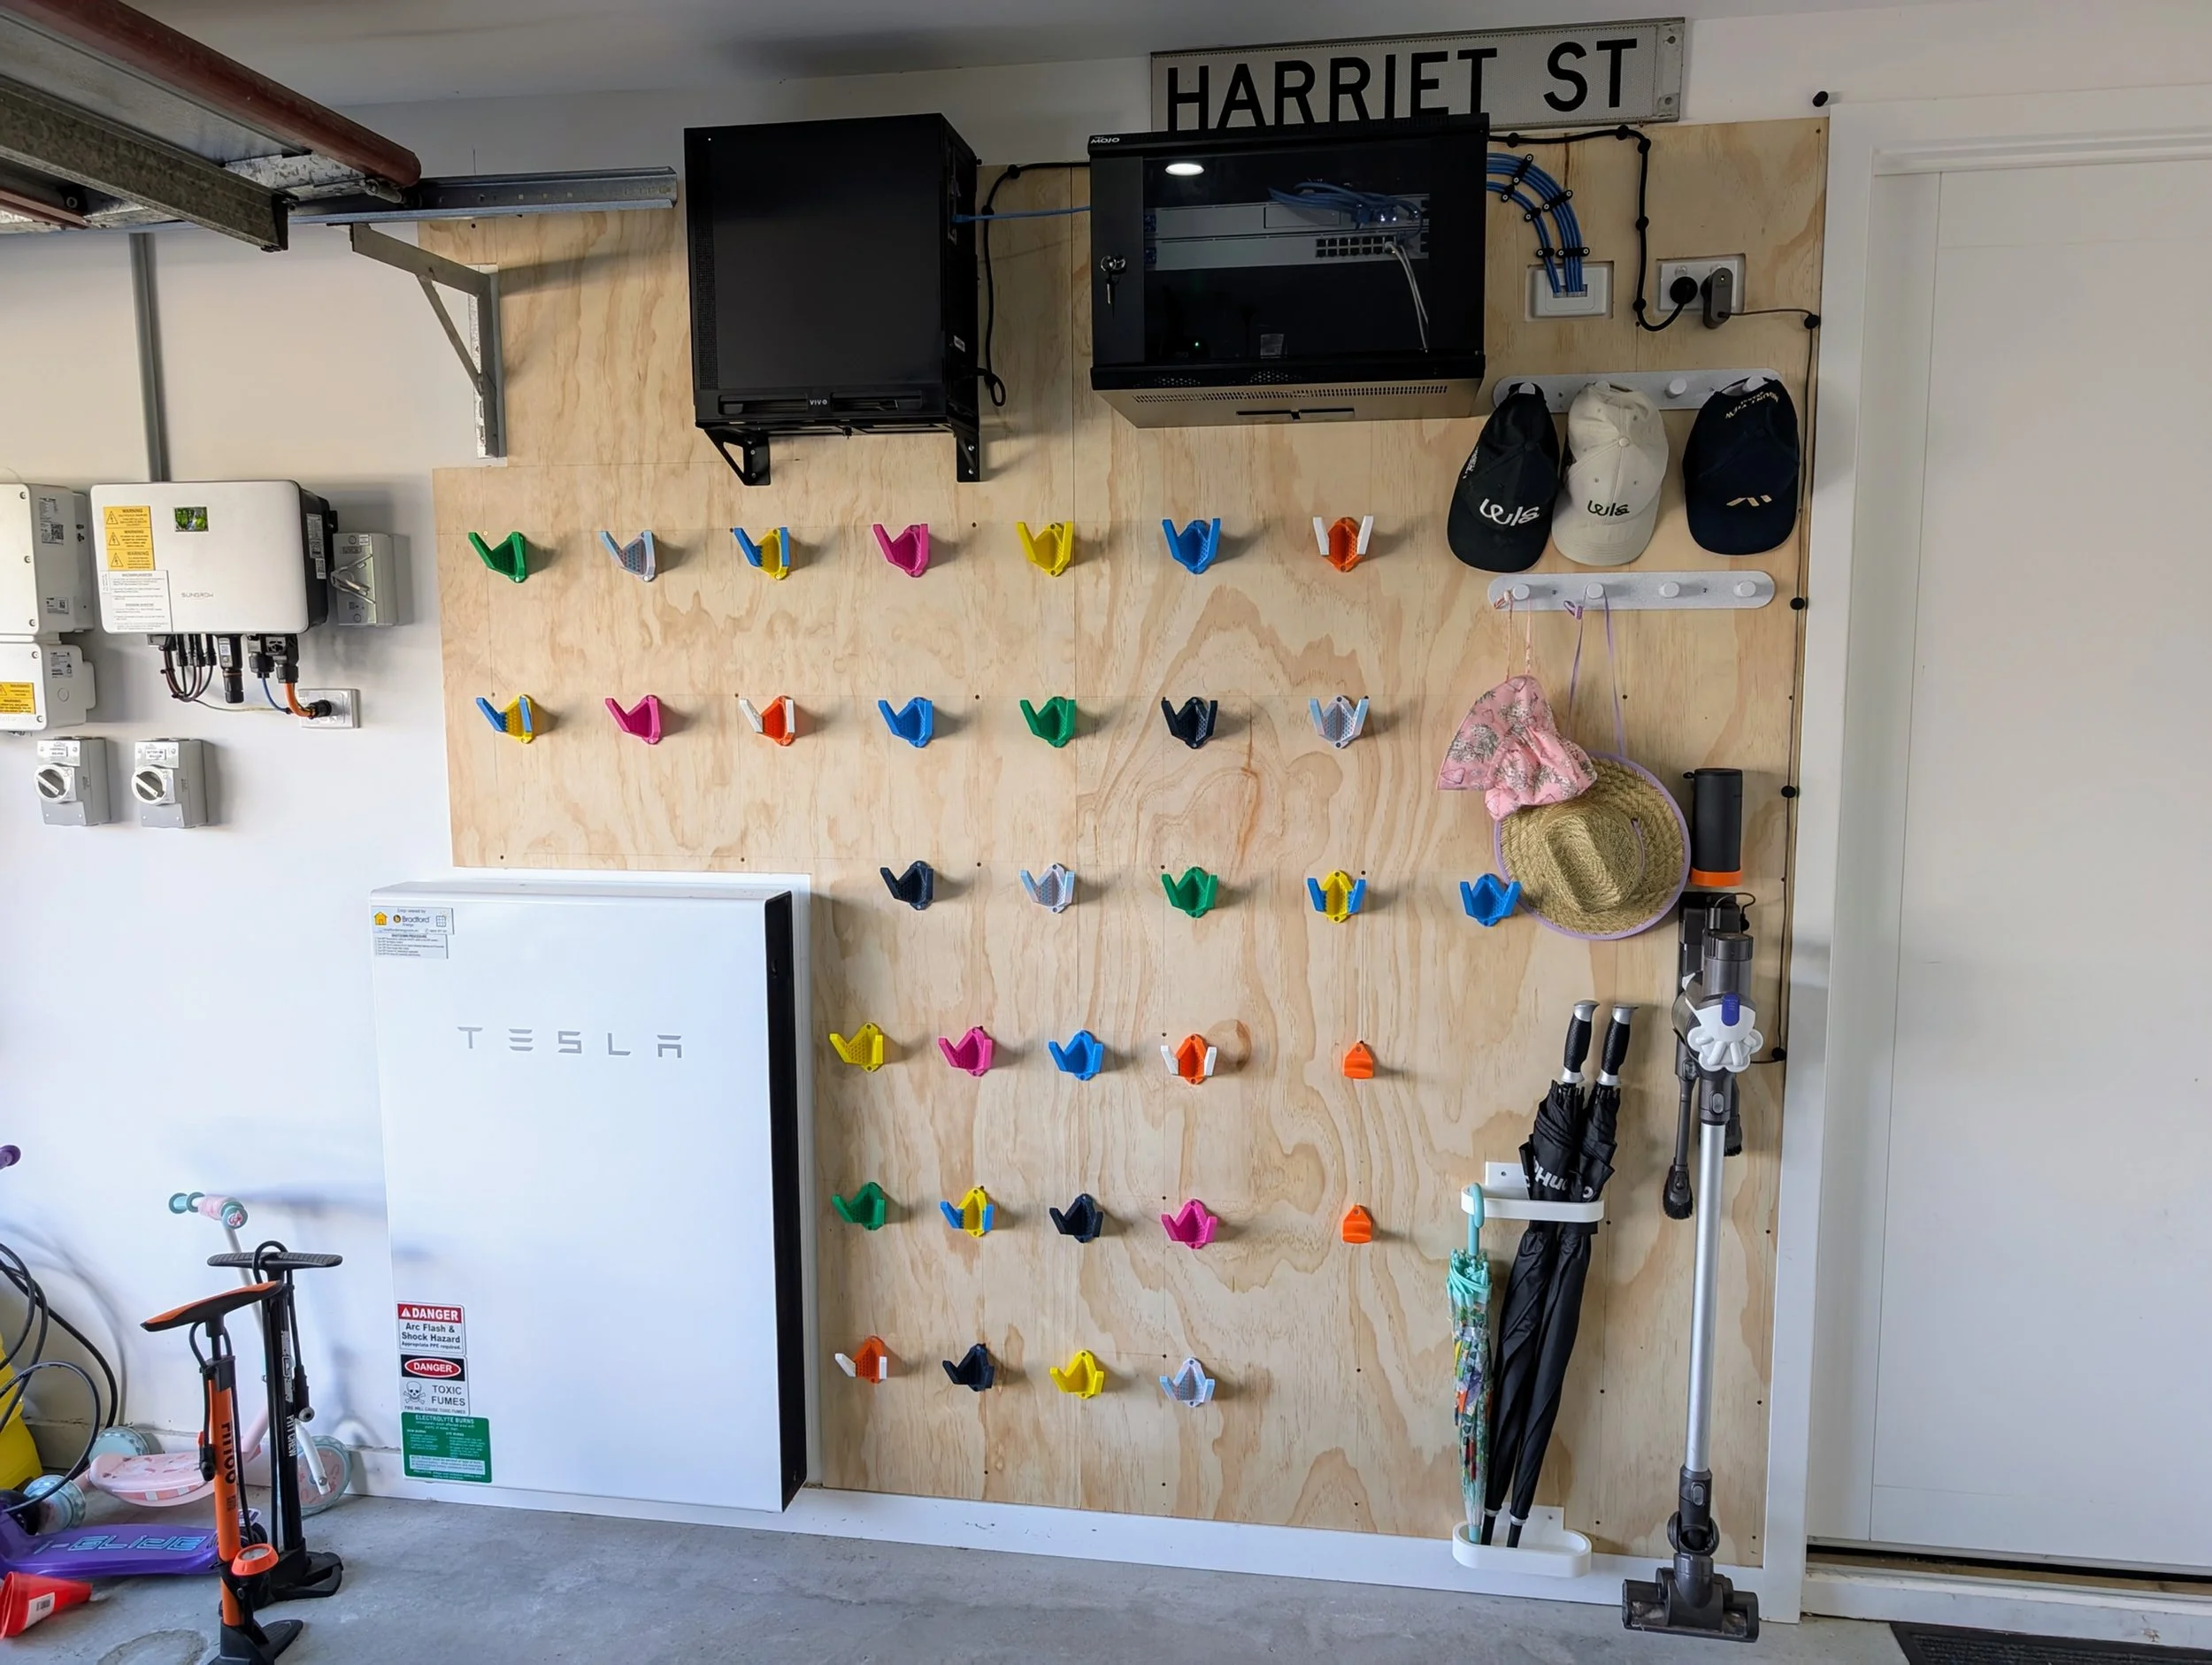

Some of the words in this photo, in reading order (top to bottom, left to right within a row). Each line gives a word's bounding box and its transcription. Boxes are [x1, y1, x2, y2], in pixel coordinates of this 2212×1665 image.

[1167, 47, 1497, 131] HARRIET
[1543, 38, 1638, 112] ST
[402, 915, 430, 924] Bradford
[457, 1026, 682, 1058] TESLA
[411, 1307, 459, 1321] DANGER
[405, 1322, 420, 1331] Arc
[423, 1324, 446, 1332] Flash
[401, 1331, 428, 1341] Shock
[430, 1333, 461, 1343] Hazard
[413, 1362, 453, 1373] DANGER
[432, 1385, 462, 1395] TOXIC
[431, 1395, 466, 1407] FUMES
[415, 1414, 454, 1423] ELECTROLYTE
